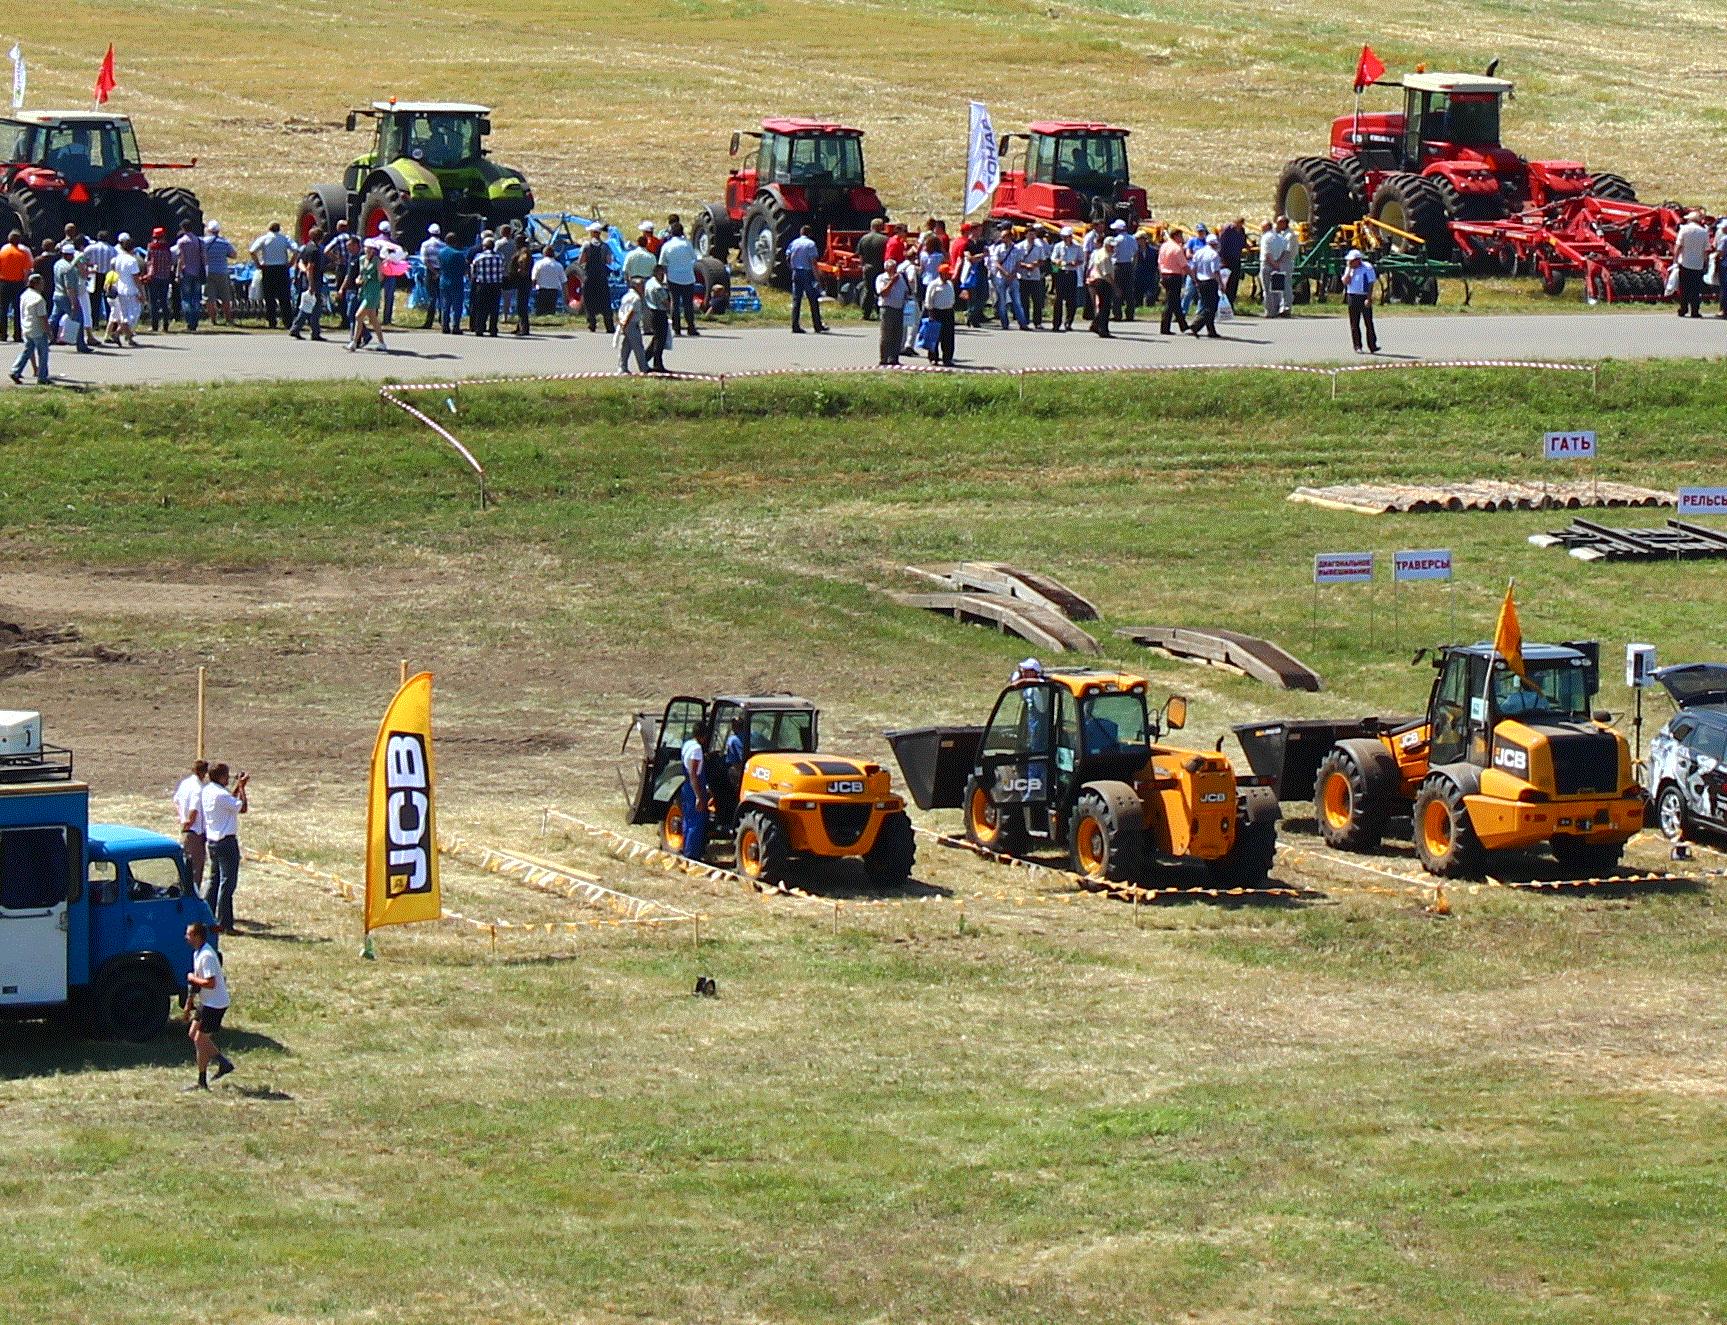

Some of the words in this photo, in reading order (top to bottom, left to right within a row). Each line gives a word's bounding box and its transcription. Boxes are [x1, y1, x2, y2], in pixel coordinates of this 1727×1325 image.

[1551, 436, 1590, 451] ГАТЬ
[1396, 560, 1450, 570] ТРАВЕРСЫ
[1400, 732, 1419, 748] JCB
[1495, 748, 1527, 769] JCB
[751, 766, 771, 781] JCB
[827, 781, 864, 793] JCB
[1003, 778, 1042, 792] JCB
[1200, 793, 1226, 802] JCB
[387, 735, 428, 889] JCB
